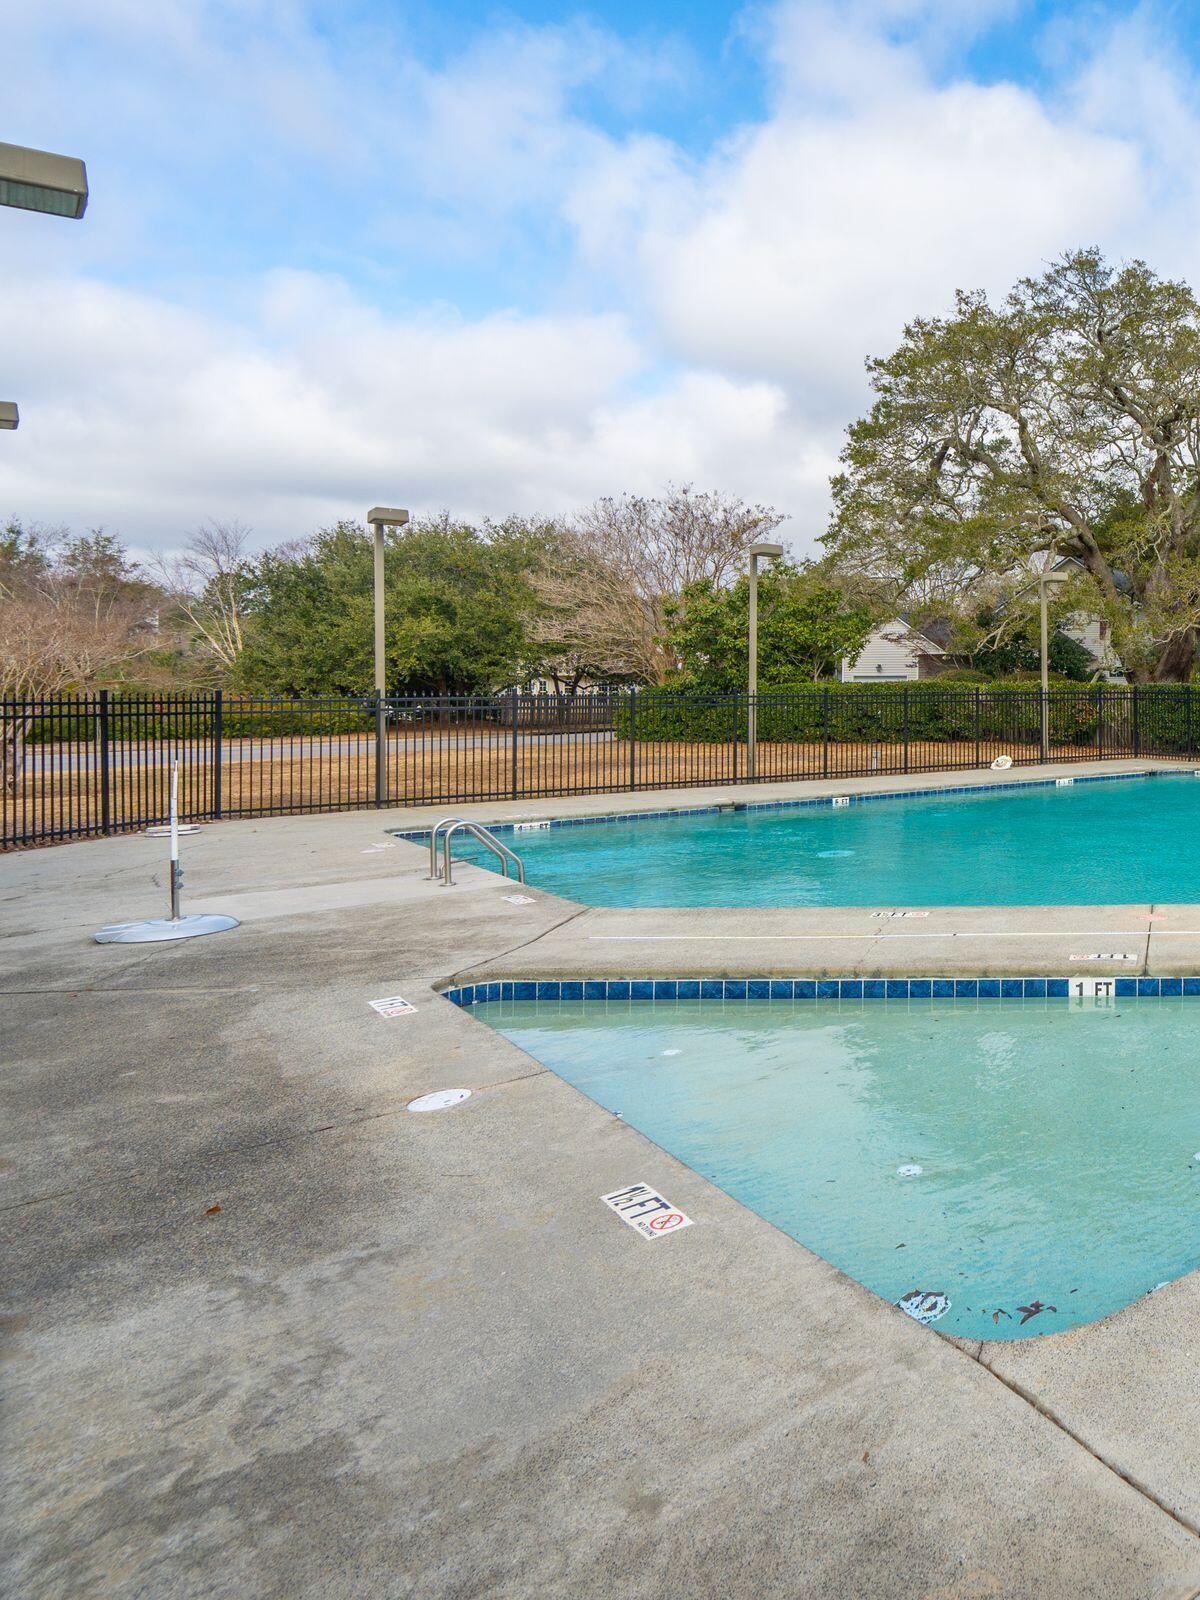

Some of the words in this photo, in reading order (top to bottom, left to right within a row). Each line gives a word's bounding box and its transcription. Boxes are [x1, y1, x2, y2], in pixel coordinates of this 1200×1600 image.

[1075, 982, 1083, 996] 1
[1095, 982, 1112, 996] FT
[620, 1196, 672, 1219] FT
